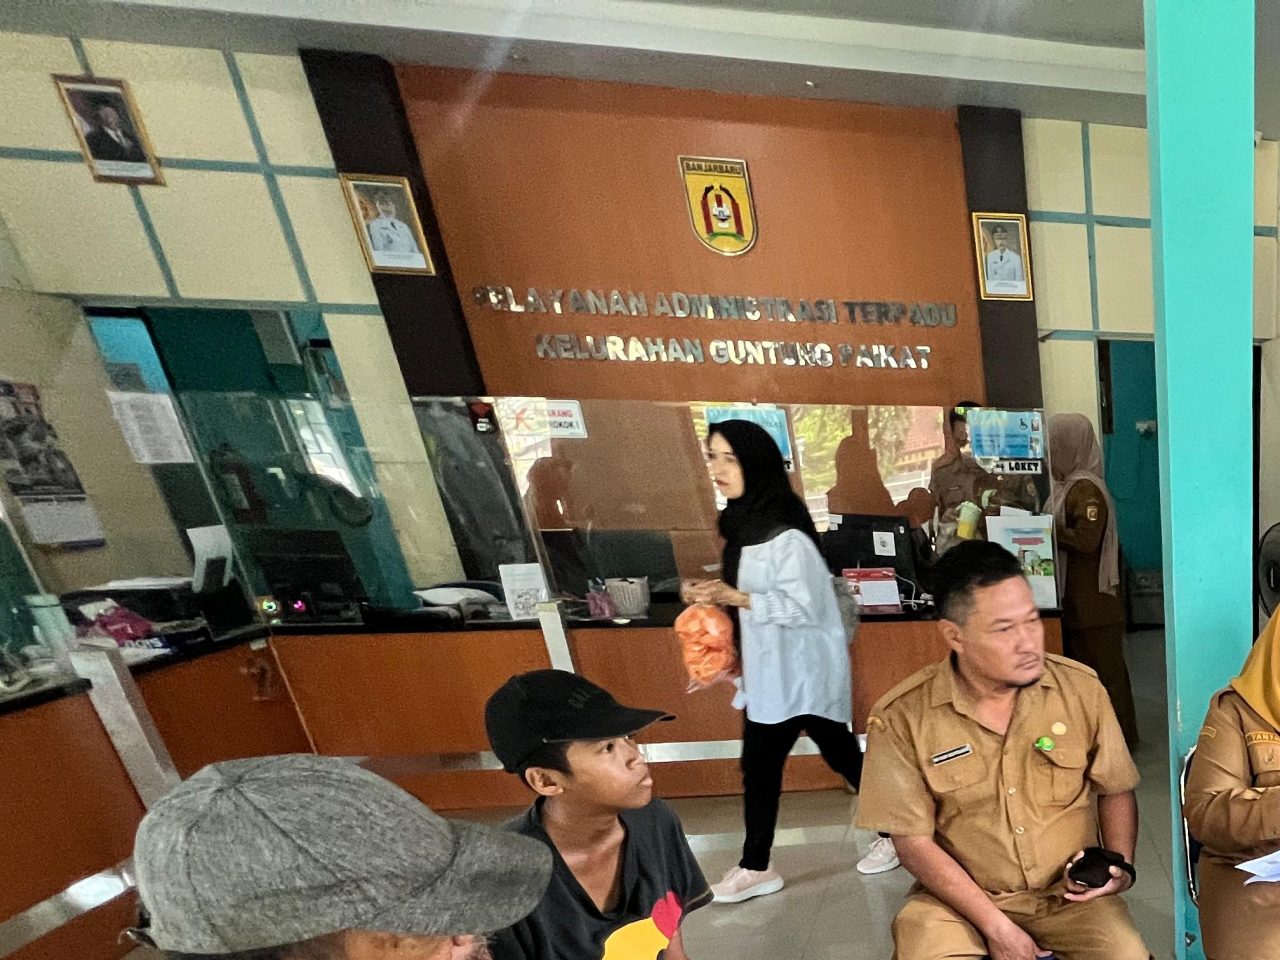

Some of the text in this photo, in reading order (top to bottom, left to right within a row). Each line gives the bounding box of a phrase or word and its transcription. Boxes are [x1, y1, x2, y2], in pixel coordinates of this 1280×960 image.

[685, 162, 742, 175] BANJARBARU
[473, 286, 958, 328] PELAYANAN ADMINISTRASI TERPADU
[535, 334, 931, 370] KELURAHAN GUNTUNG PAIKAT
[1008, 461, 1040, 471] LOKET
